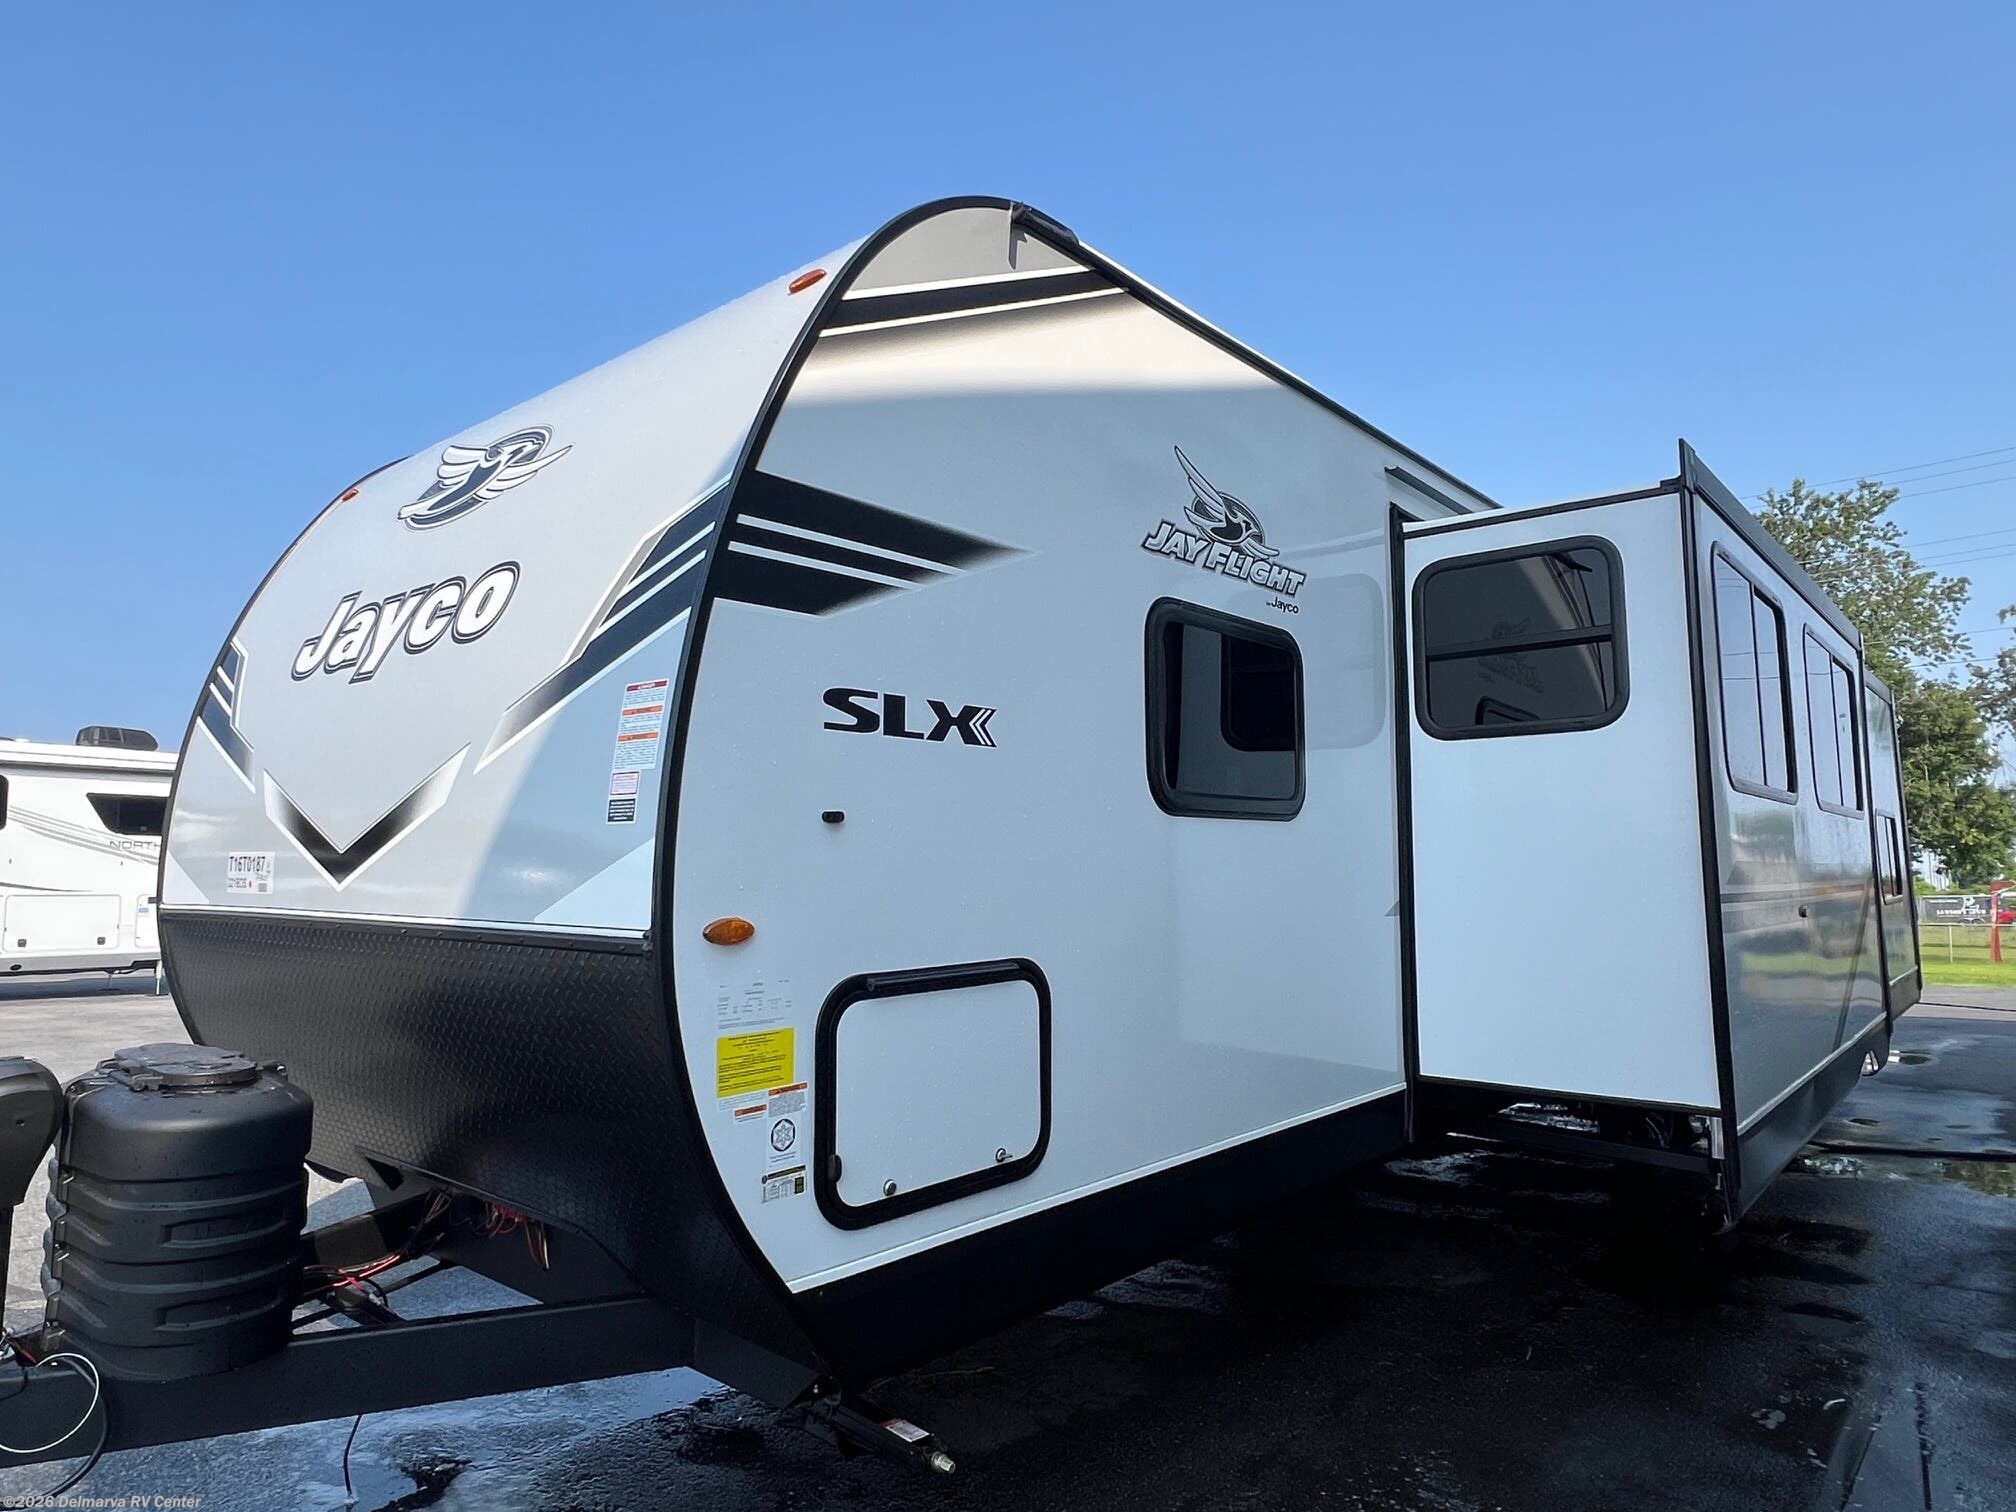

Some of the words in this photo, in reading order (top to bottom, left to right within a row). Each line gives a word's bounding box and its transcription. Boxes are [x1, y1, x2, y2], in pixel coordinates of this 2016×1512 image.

[1141, 519, 1209, 564] JAY
[1203, 541, 1307, 597] FLIGHT
[291, 560, 521, 684] Jayco
[1271, 596, 1299, 614] Jayco
[823, 687, 998, 749] SLX
